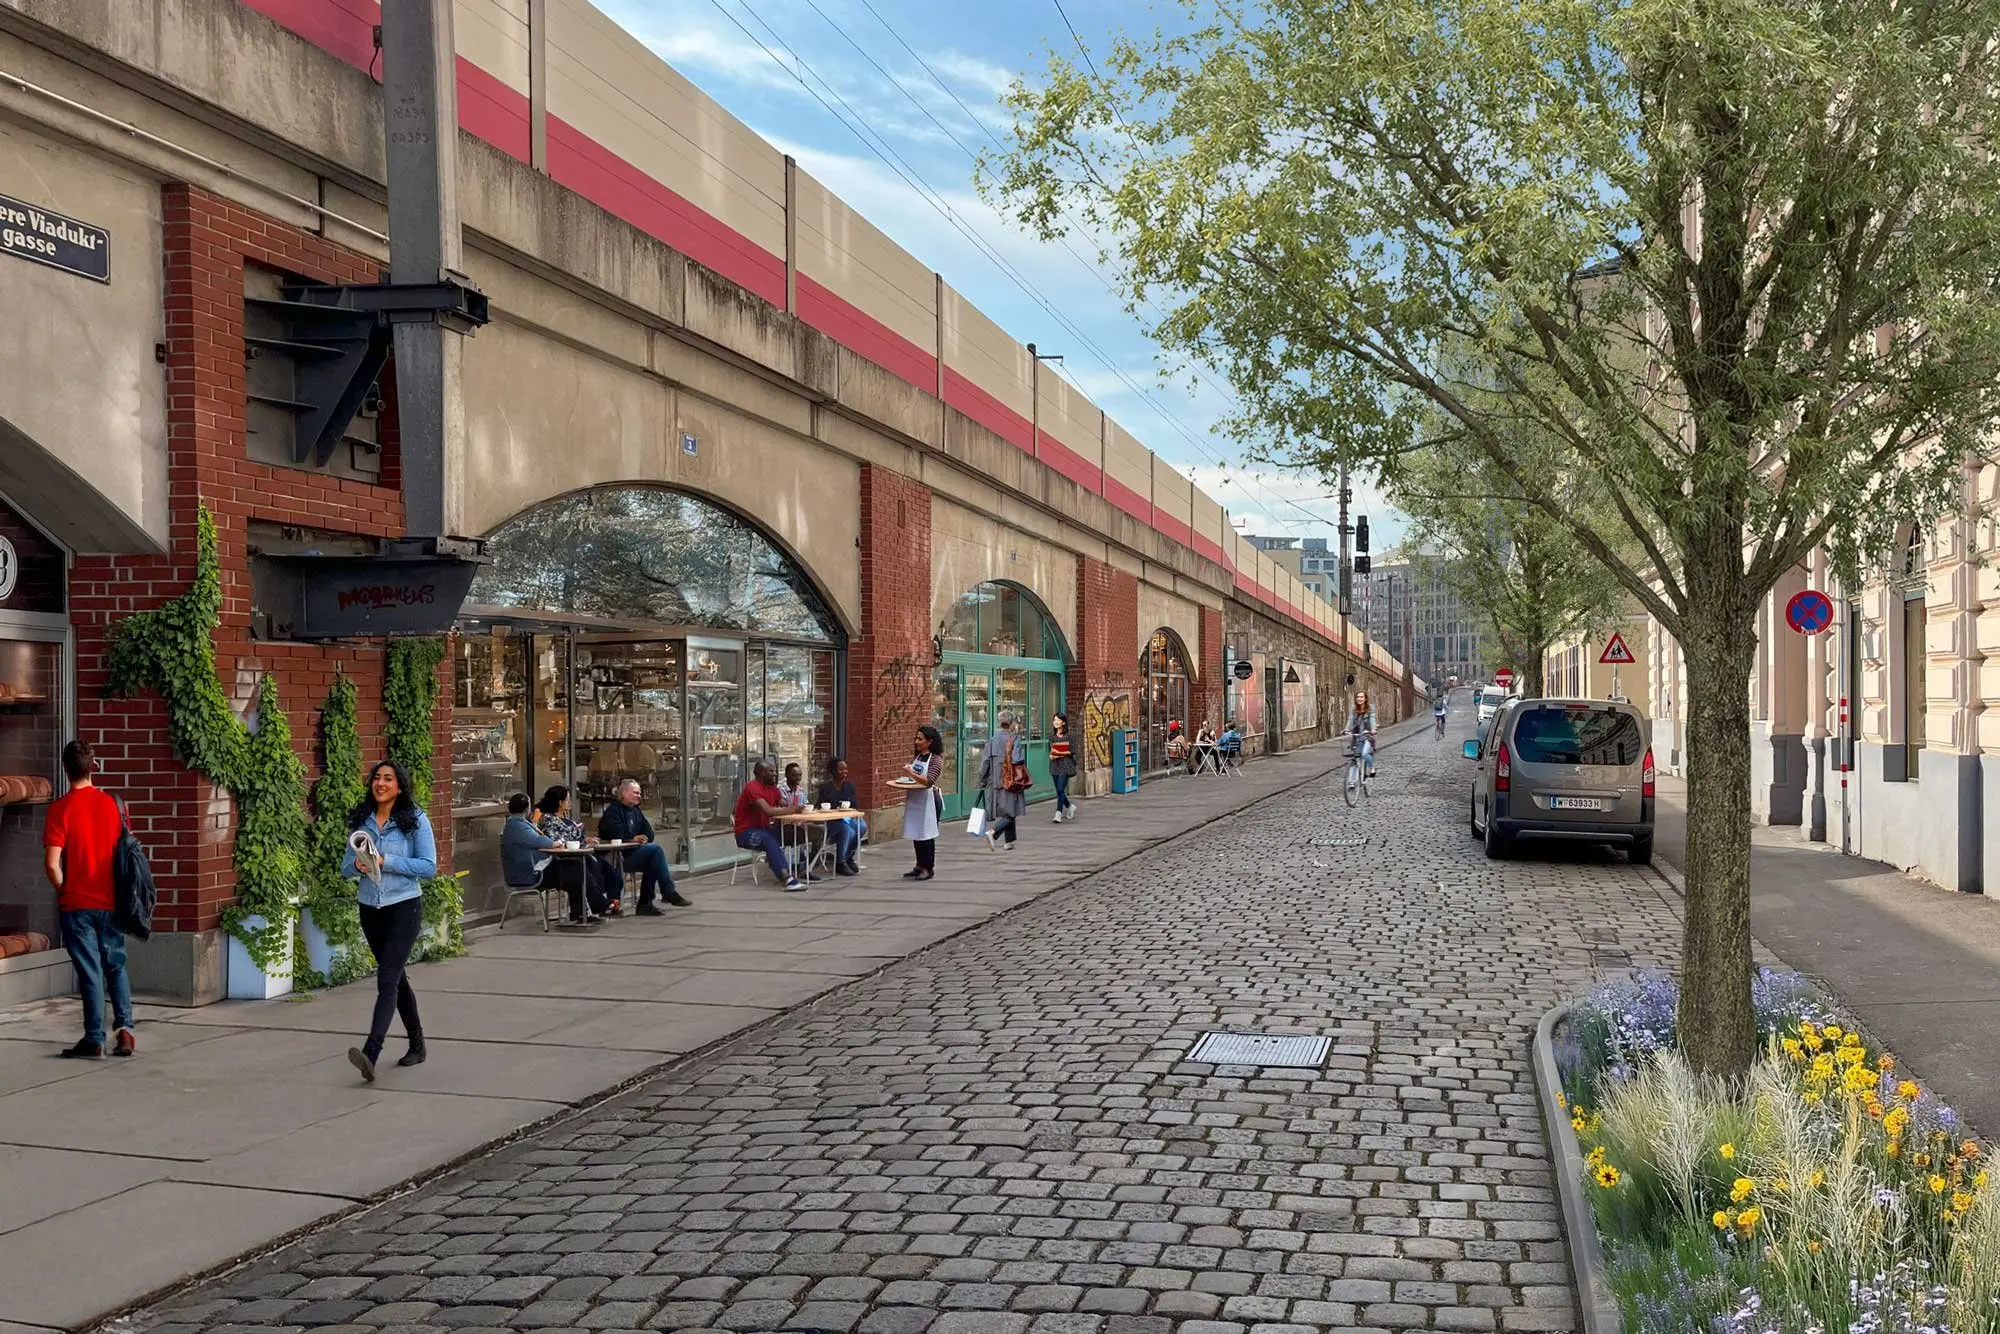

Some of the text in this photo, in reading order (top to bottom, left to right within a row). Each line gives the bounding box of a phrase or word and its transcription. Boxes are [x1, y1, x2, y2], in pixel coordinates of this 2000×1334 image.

[0, 205, 103, 250] ere Viadukt-
[3, 228, 56, 256] gasse
[1568, 799, 1593, 808] 63933
